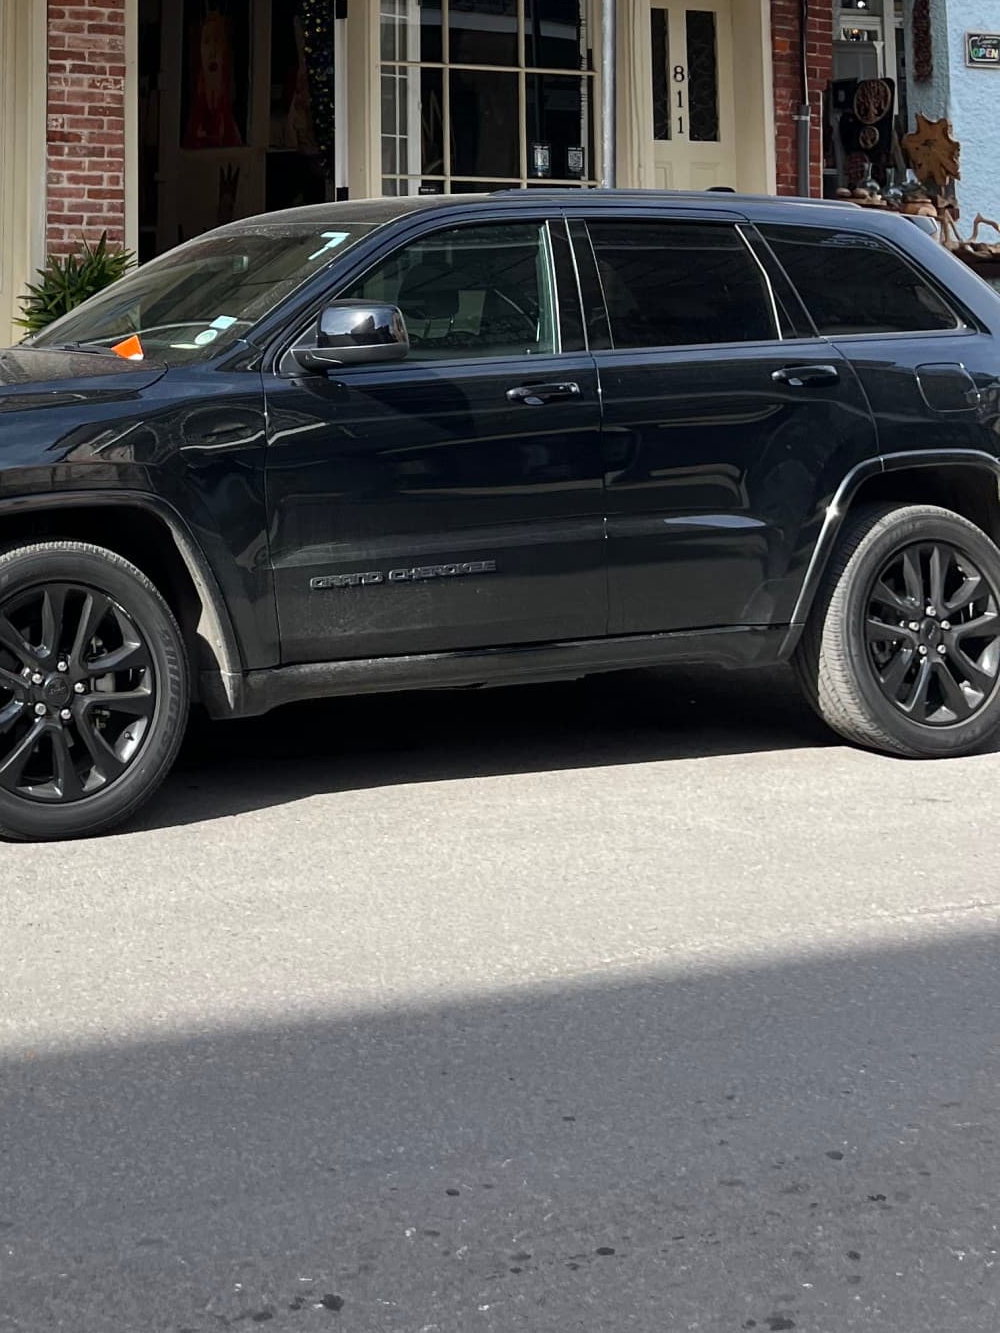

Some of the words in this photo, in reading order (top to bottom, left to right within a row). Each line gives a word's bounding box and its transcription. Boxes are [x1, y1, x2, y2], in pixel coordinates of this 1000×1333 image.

[972, 47, 999, 58] OPEN
[674, 65, 685, 134] 811
[310, 571, 383, 588] GRAND
[389, 560, 496, 581] CHEROKEE
